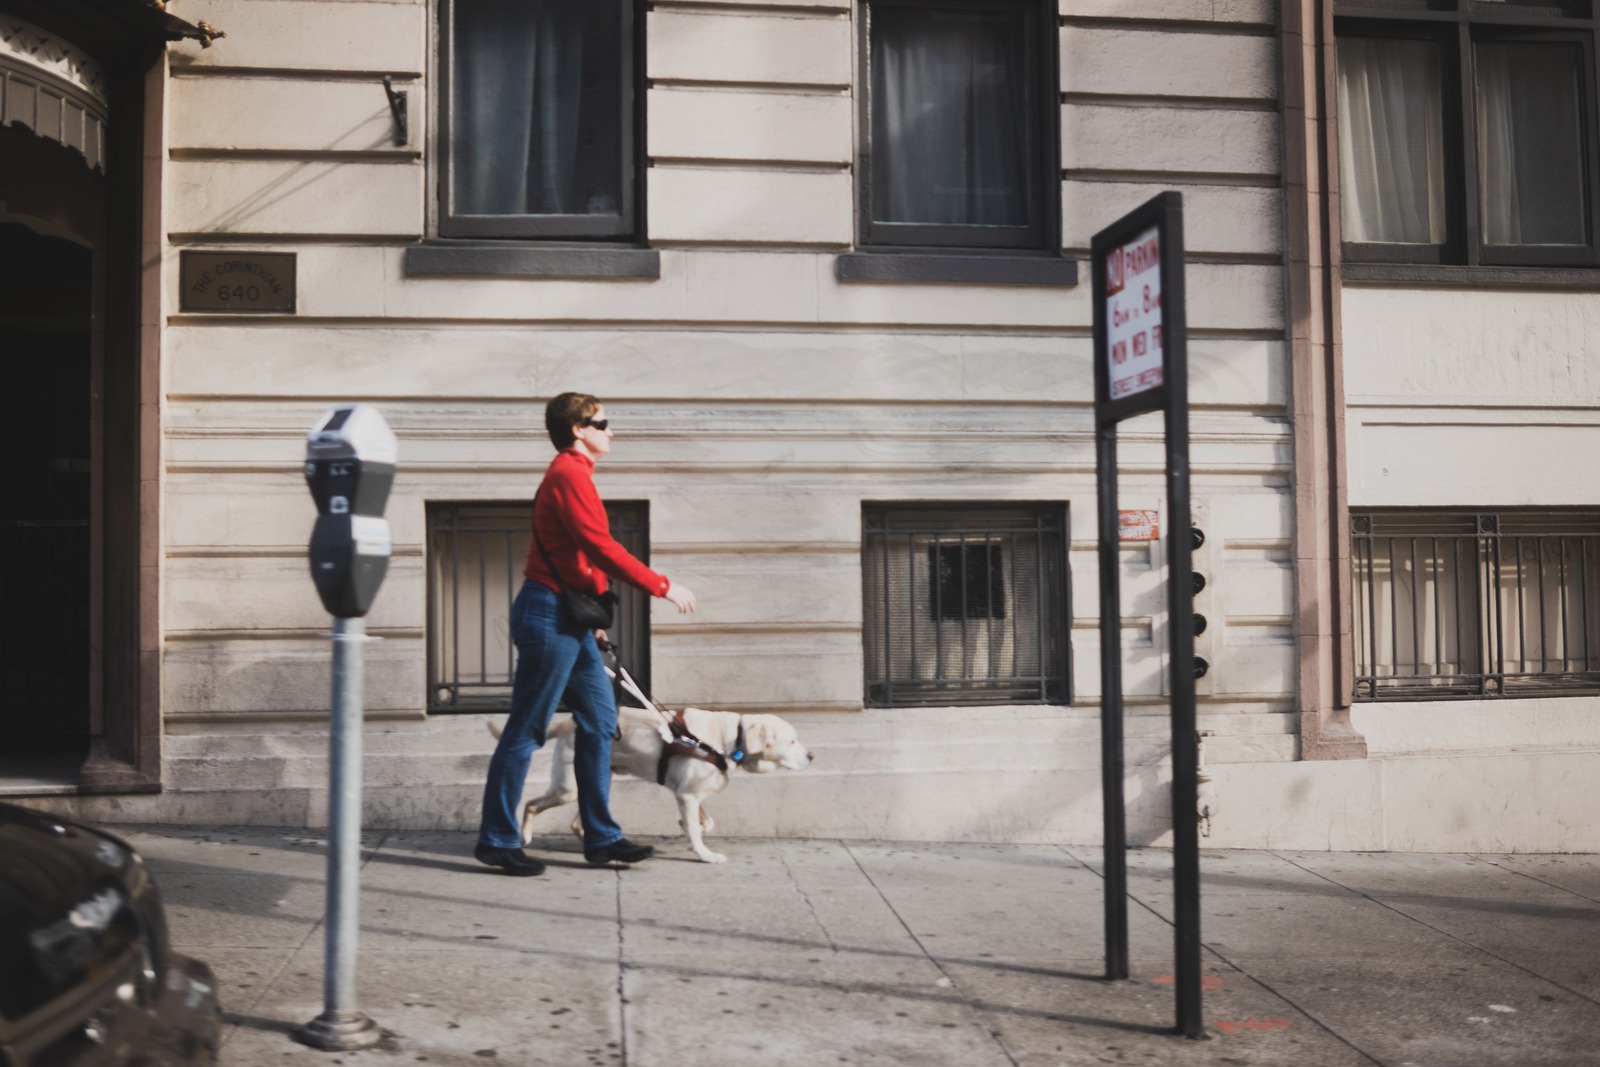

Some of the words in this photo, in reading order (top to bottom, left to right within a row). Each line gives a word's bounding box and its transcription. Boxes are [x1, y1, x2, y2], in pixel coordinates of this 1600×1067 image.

[1124, 238, 1160, 281] PARKIN
[193, 271, 215, 294] THE
[215, 260, 283, 294] CORINTHIAN
[218, 285, 259, 302] 640
[1112, 340, 1127, 366] MON
[1132, 331, 1147, 358] WED
